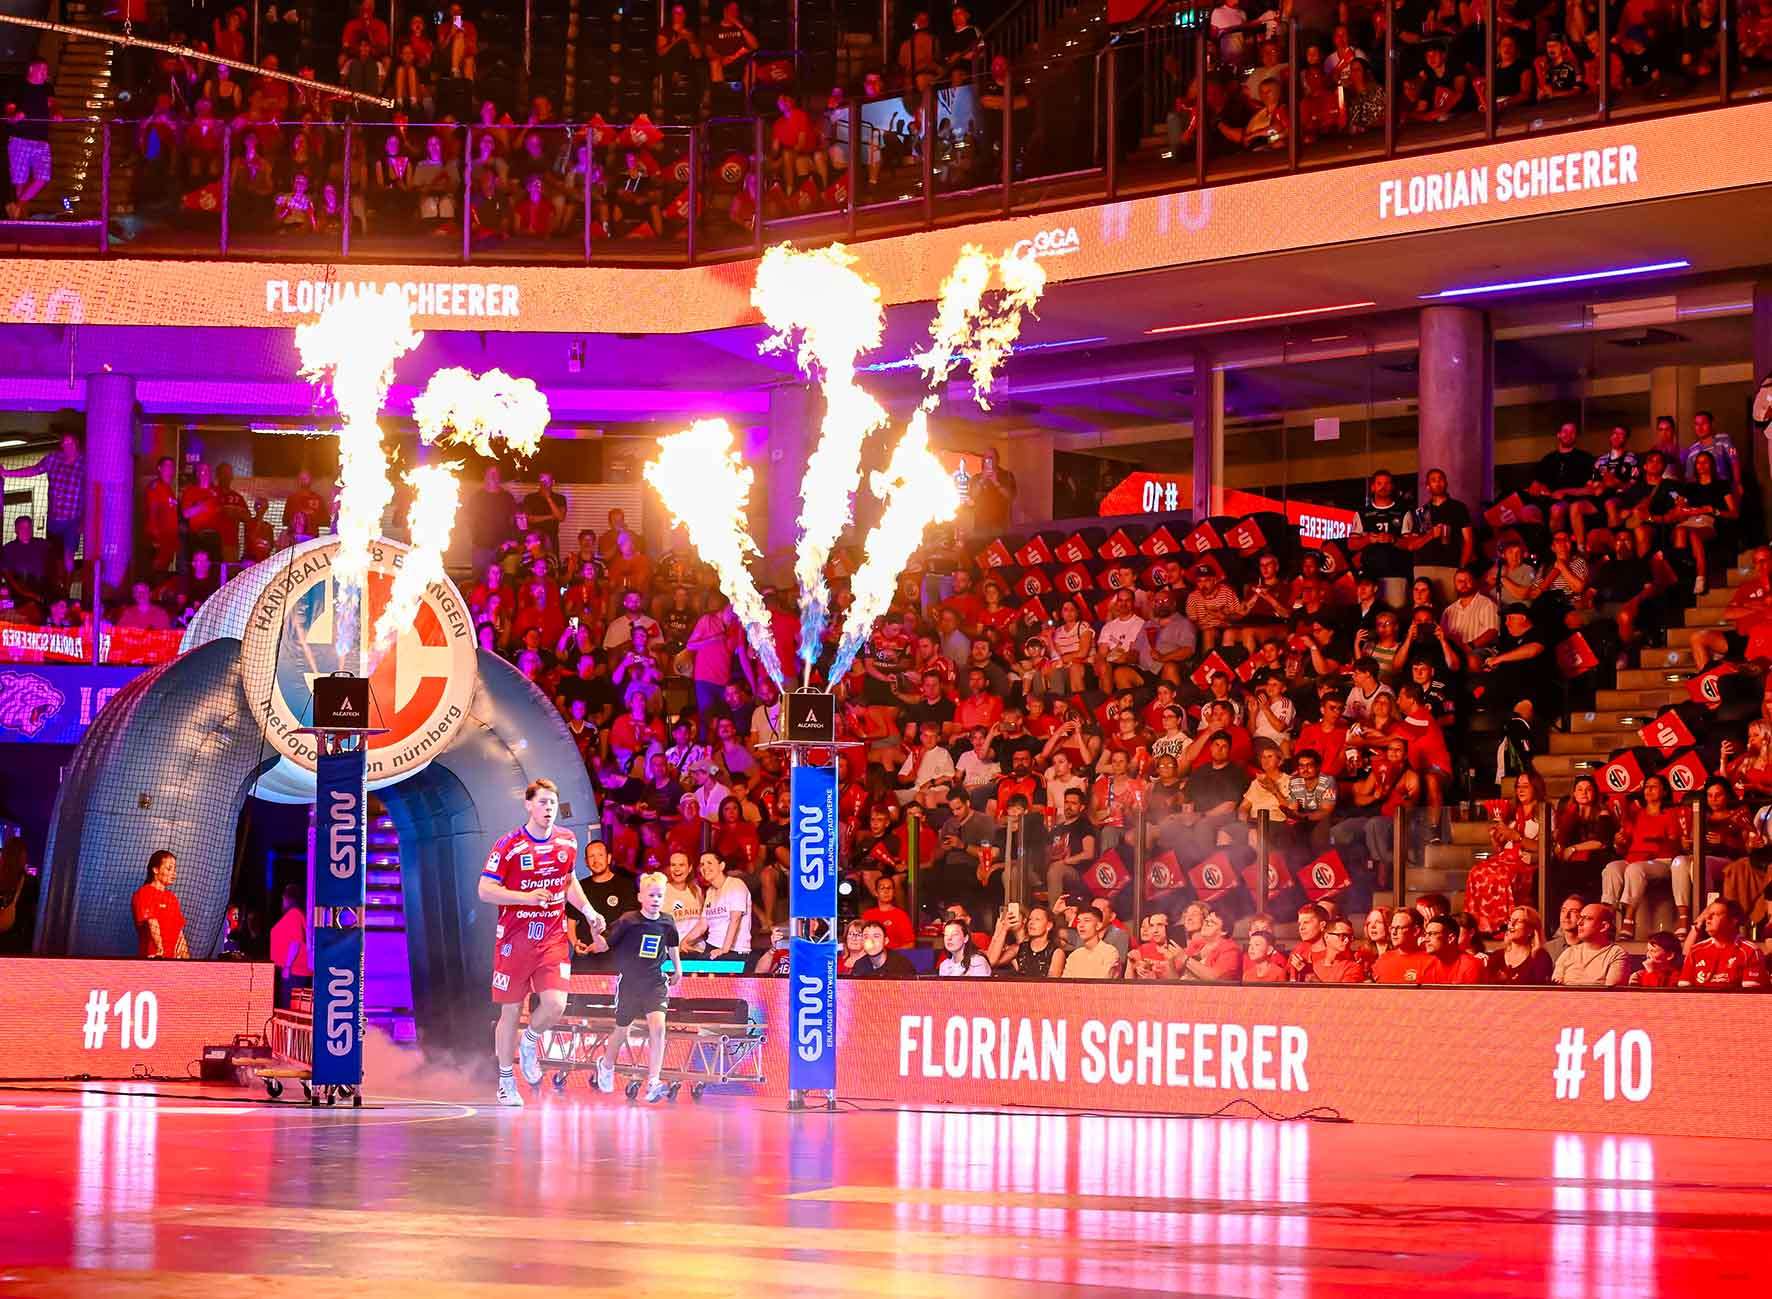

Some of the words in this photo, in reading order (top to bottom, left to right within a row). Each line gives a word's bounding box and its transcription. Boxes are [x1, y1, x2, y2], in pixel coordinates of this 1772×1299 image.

[1379, 166, 1488, 219] FLORIAN
[1496, 145, 1637, 202] SCHEERER
[383, 281, 520, 317] CHEERER
[392, 703, 462, 768] nürnberg
[330, 790, 356, 879] ESTW
[826, 788, 834, 836] STADTWERKE
[799, 805, 824, 890] ESTW
[528, 922, 544, 940] 10
[83, 989, 158, 1049] #10
[327, 966, 354, 1057] ESTW
[798, 975, 823, 1062] ESTW
[826, 961, 834, 1009] STADTWERKE
[826, 1011, 834, 1049] ERLANGER
[900, 1015, 1067, 1081] FLORIAN
[1081, 1020, 1309, 1092] SCHEERER
[1553, 1027, 1651, 1101] #10
